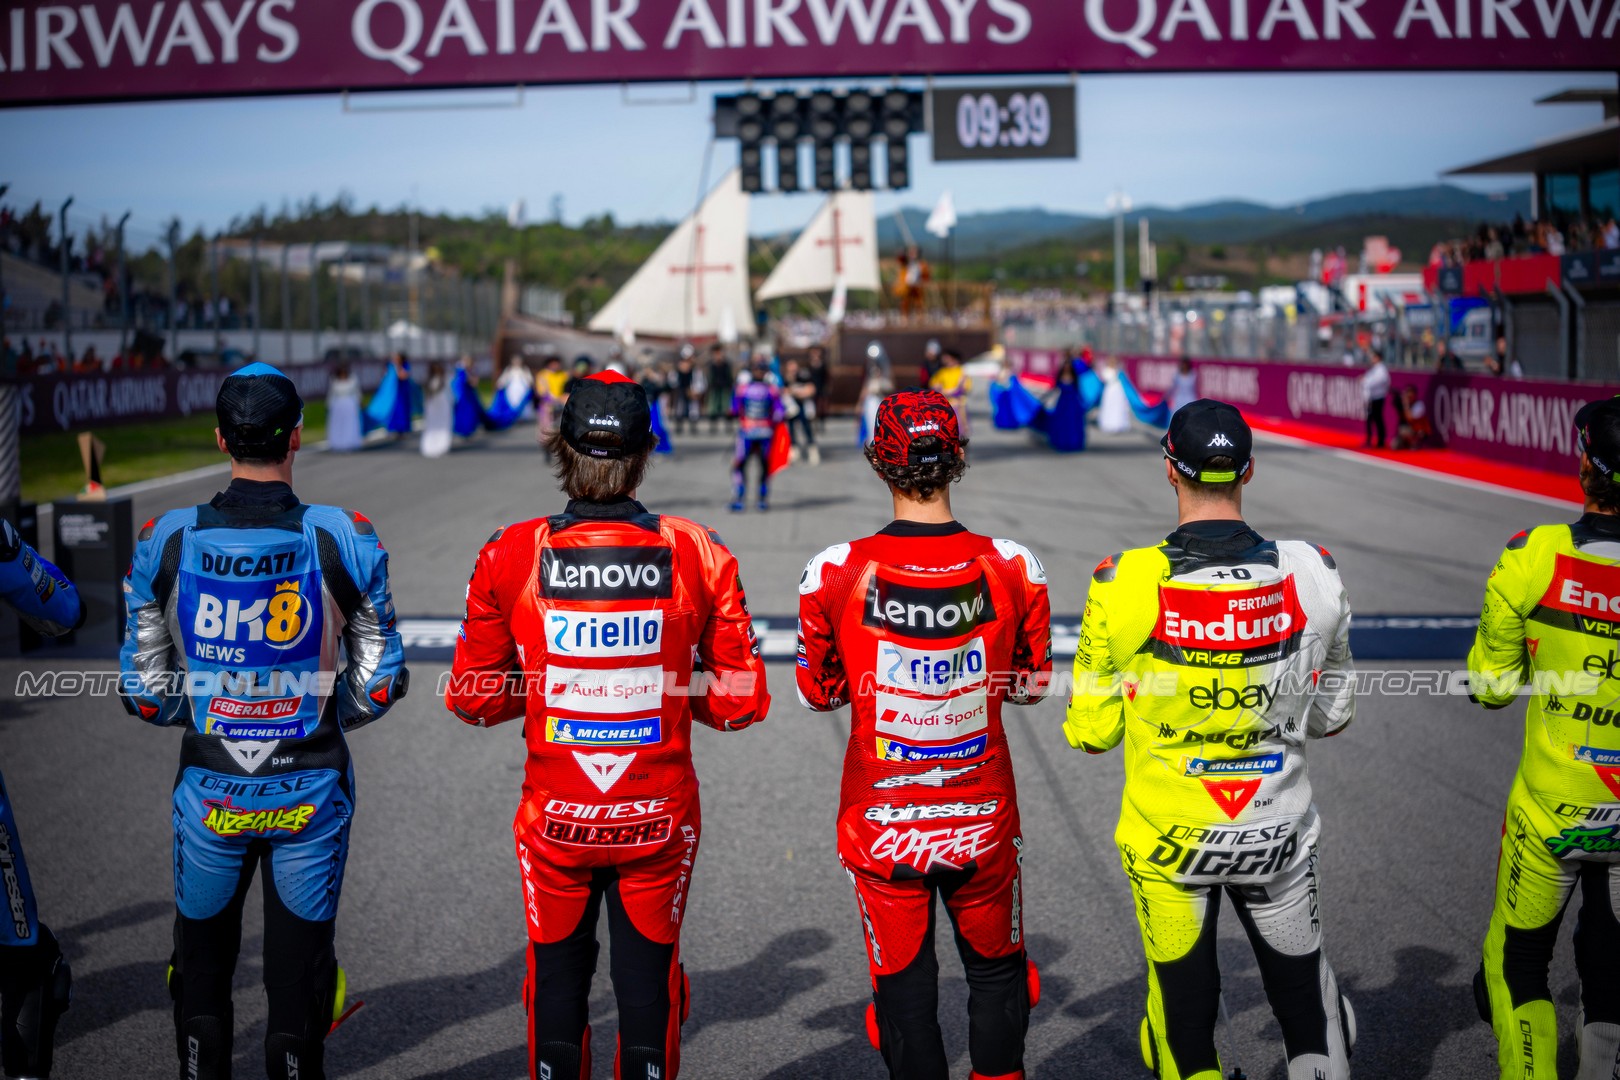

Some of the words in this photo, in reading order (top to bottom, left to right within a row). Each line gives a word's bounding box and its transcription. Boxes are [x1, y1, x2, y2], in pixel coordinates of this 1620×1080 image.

[0, 0, 300, 72] IRWAYS
[351, 0, 645, 74] QATAR
[664, 0, 1032, 50] AIRWAYS
[956, 92, 1051, 149] 09:39
[1177, 460, 1197, 478] ebay
[203, 551, 296, 577] DUCATI
[550, 560, 661, 588] Lenovo
[872, 588, 985, 628] Lenovo
[1228, 592, 1285, 611] PERTAMIN
[194, 591, 303, 643] BK8
[1164, 611, 1292, 642] Enduro
[575, 616, 659, 648] riello
[196, 641, 246, 664] NEWS
[1243, 653, 1267, 665] RACING
[911, 648, 983, 686] riello
[571, 683, 609, 697] Audi
[613, 682, 659, 700] Sport
[1188, 678, 1281, 712] ebay
[213, 699, 269, 716] FEDERAL
[272, 699, 295, 713] OIL
[900, 712, 940, 726] Audi
[944, 704, 984, 726] Sport
[229, 727, 298, 738] MICHELIN
[577, 726, 653, 739] MICHELIN
[1183, 723, 1282, 750] DUCATI
[1207, 759, 1278, 771] MICHELIN
[199, 774, 317, 797] DAINESE
[203, 805, 315, 835] ALDEGUER
[544, 797, 669, 819] DAINESE
[864, 800, 998, 826] alpinestars
[1166, 822, 1291, 846] DAINESE
[1146, 832, 1298, 876] DIGGIA
[1519, 1019, 1535, 1080] DAINE
